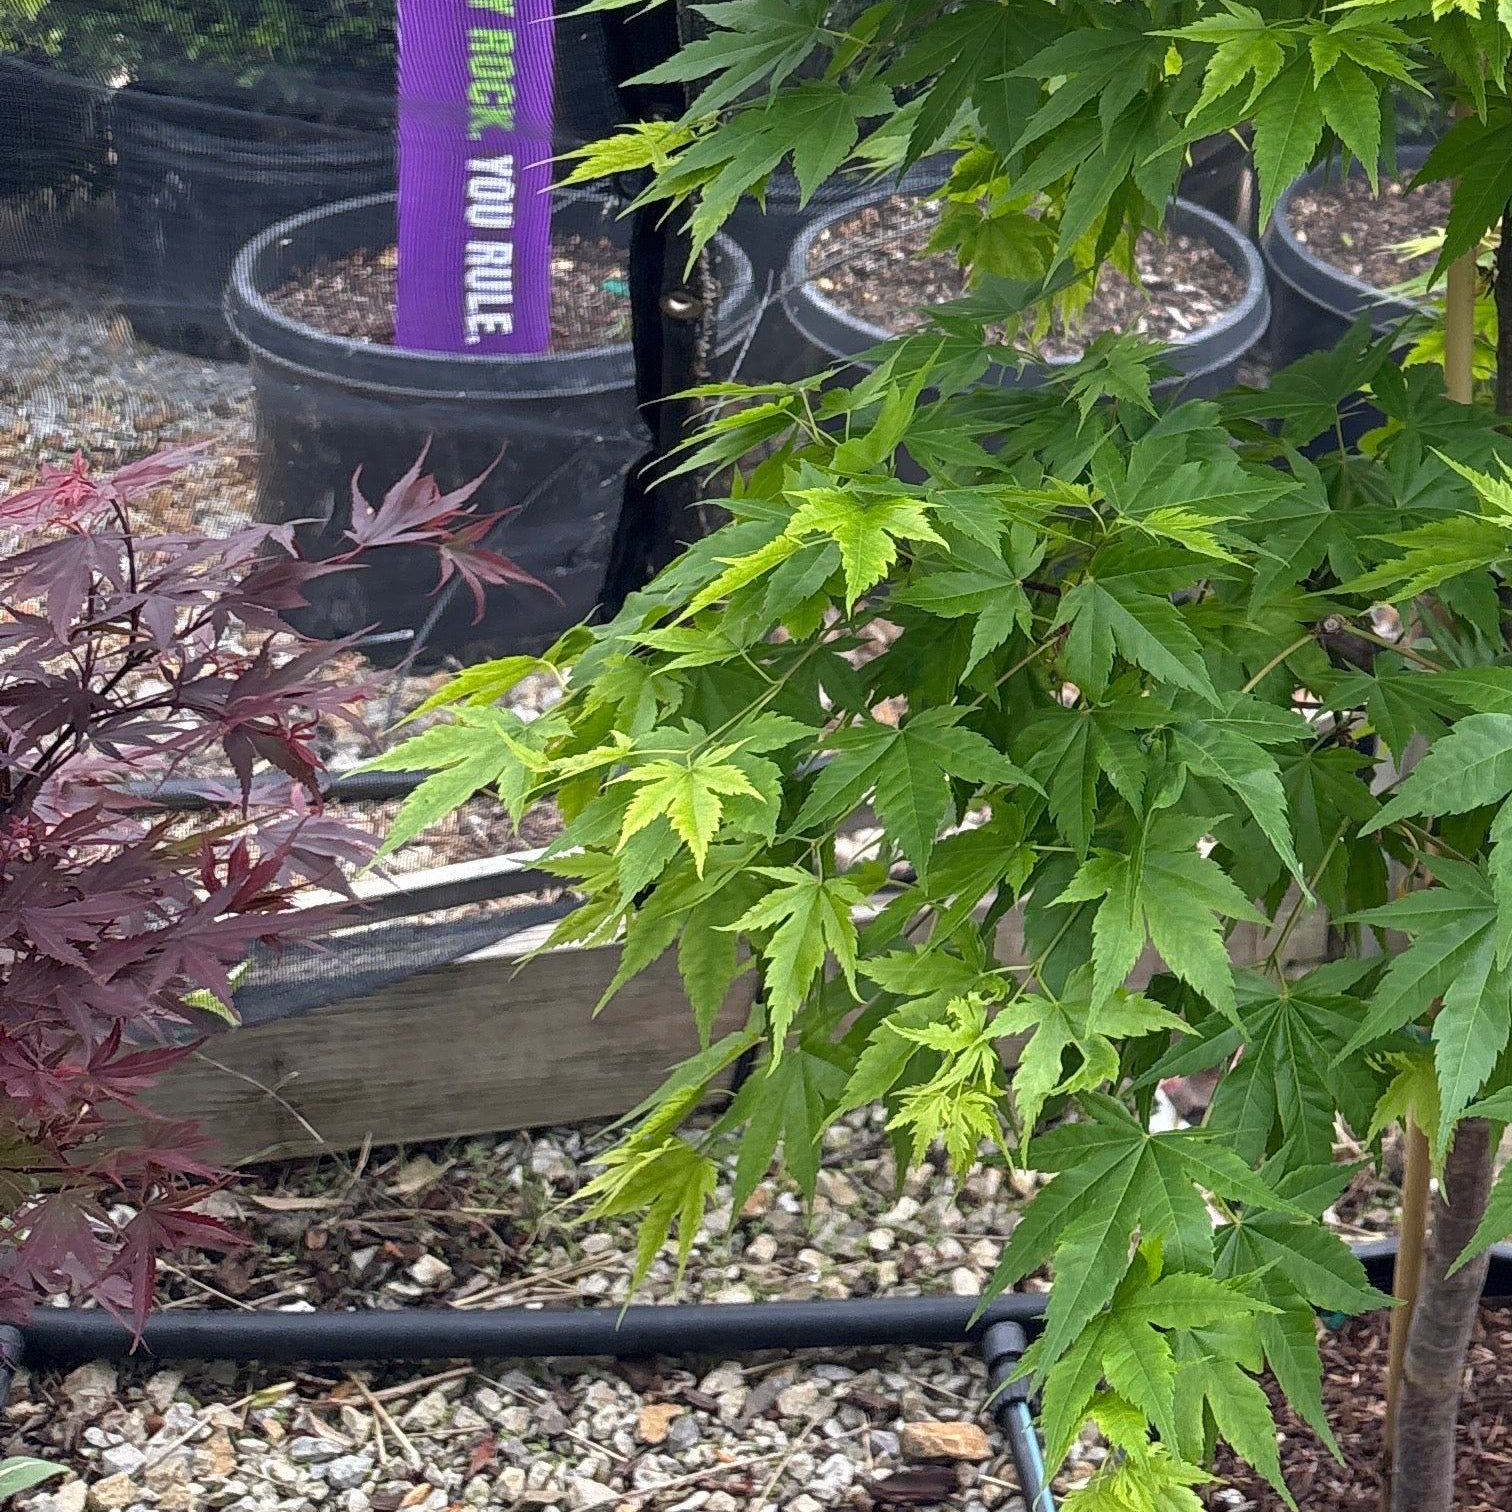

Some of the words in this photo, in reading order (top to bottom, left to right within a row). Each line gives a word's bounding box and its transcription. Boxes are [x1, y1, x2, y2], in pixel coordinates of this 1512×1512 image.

[466, 27, 516, 141] ROCK.
[464, 154, 515, 229] YOU
[464, 240, 515, 346] RULE.
